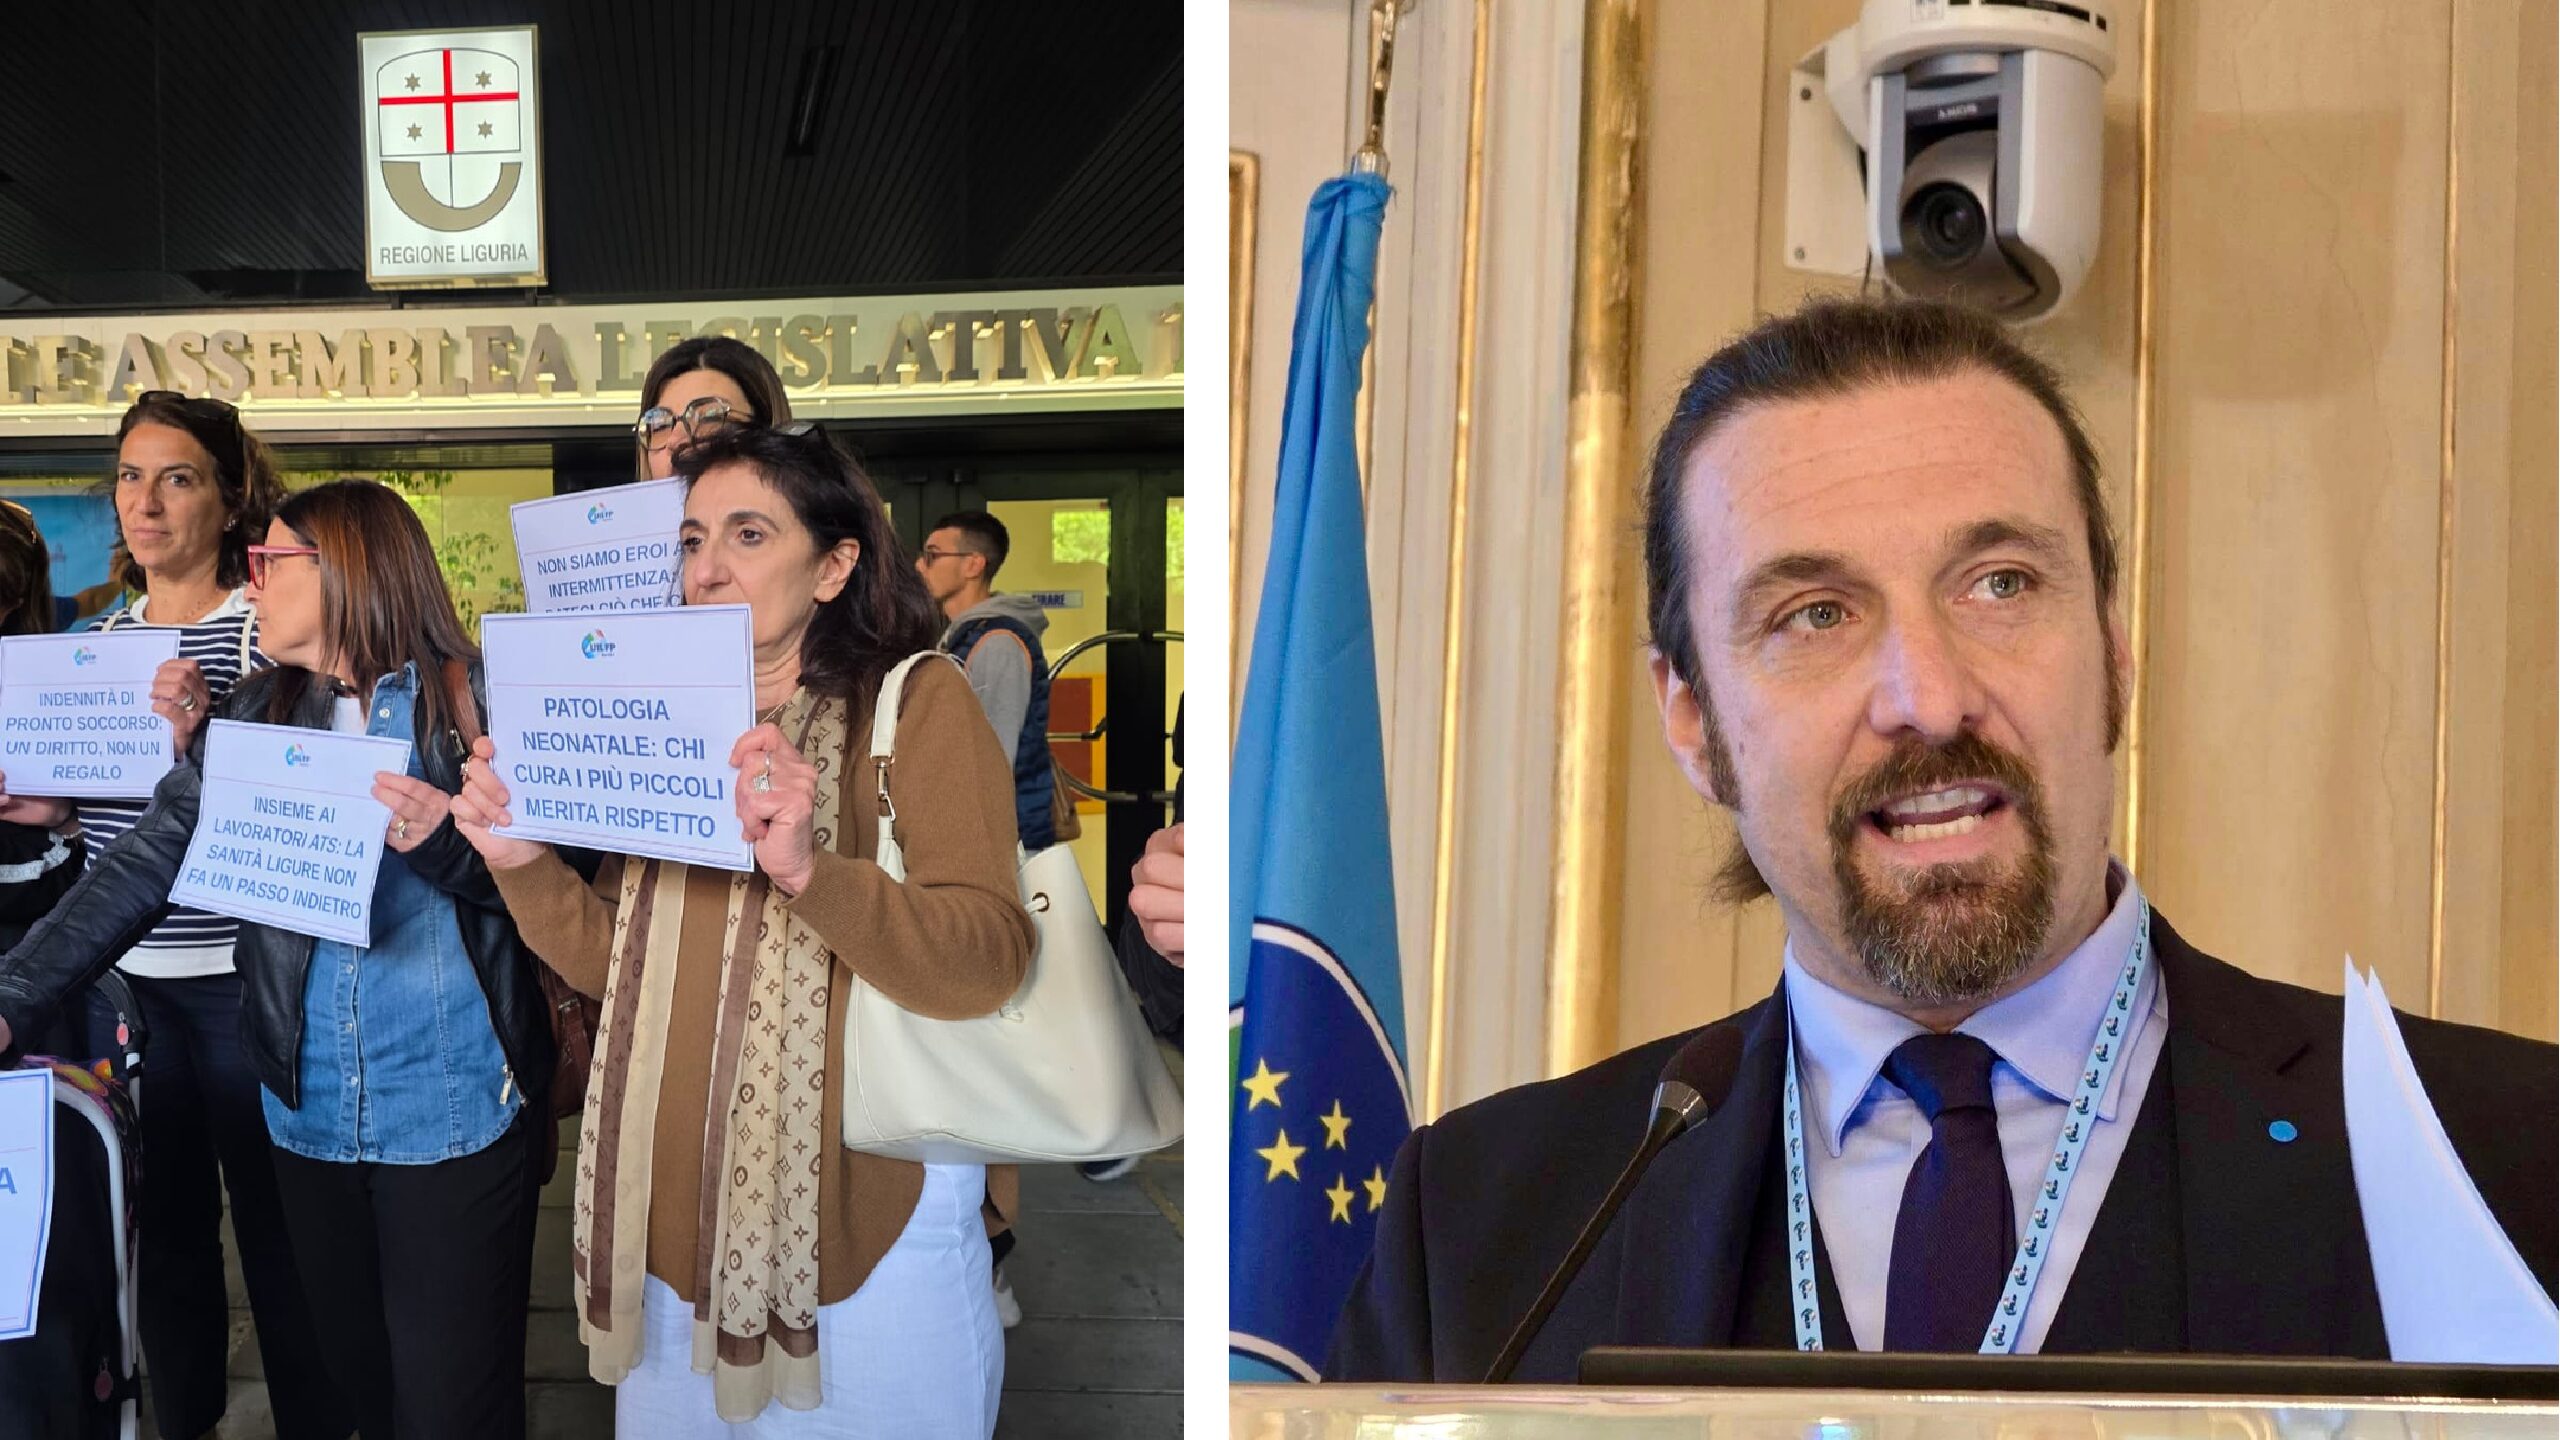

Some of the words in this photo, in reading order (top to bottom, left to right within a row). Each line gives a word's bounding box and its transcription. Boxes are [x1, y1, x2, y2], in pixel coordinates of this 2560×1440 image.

[379, 245, 456, 264] REGIONE
[461, 243, 528, 262] LIGURIA
[107, 323, 578, 402] ASSEMBLEA
[594, 303, 1142, 391] LISLATIVA
[537, 556, 566, 576] NON
[570, 549, 621, 570] SIAMO
[625, 543, 668, 563] EROI
[39, 688, 117, 707] INDENNITÀ
[121, 691, 134, 705] DI
[543, 697, 671, 721] PATOLOGIA
[6, 716, 72, 731] PRONTO
[77, 715, 163, 731] SOCCORSO:
[6, 741, 31, 755] UN
[106, 741, 138, 755] NON
[140, 741, 160, 755] UN
[522, 731, 657, 757] NEONATALE:
[665, 737, 705, 760] CHI
[52, 764, 122, 779] REGALO
[514, 764, 571, 788] CURA
[577, 768, 582, 788] I
[588, 765, 622, 790] PIÙ
[630, 773, 724, 801] PICCOLI
[254, 795, 315, 821] INSIEME
[319, 806, 335, 824] AI
[525, 797, 600, 824] MERITA
[605, 805, 716, 838] RISPETTO
[214, 818, 307, 848] LAVORATORI
[309, 834, 341, 854] ATS:
[347, 840, 364, 859] LA
[206, 844, 262, 870] SANITÀ
[267, 854, 320, 881] LIGURE
[324, 866, 357, 887] NON
[187, 868, 207, 887] FA
[210, 873, 233, 892] UN
[236, 878, 289, 903] PASSO
[292, 889, 362, 920] INDIETRO
